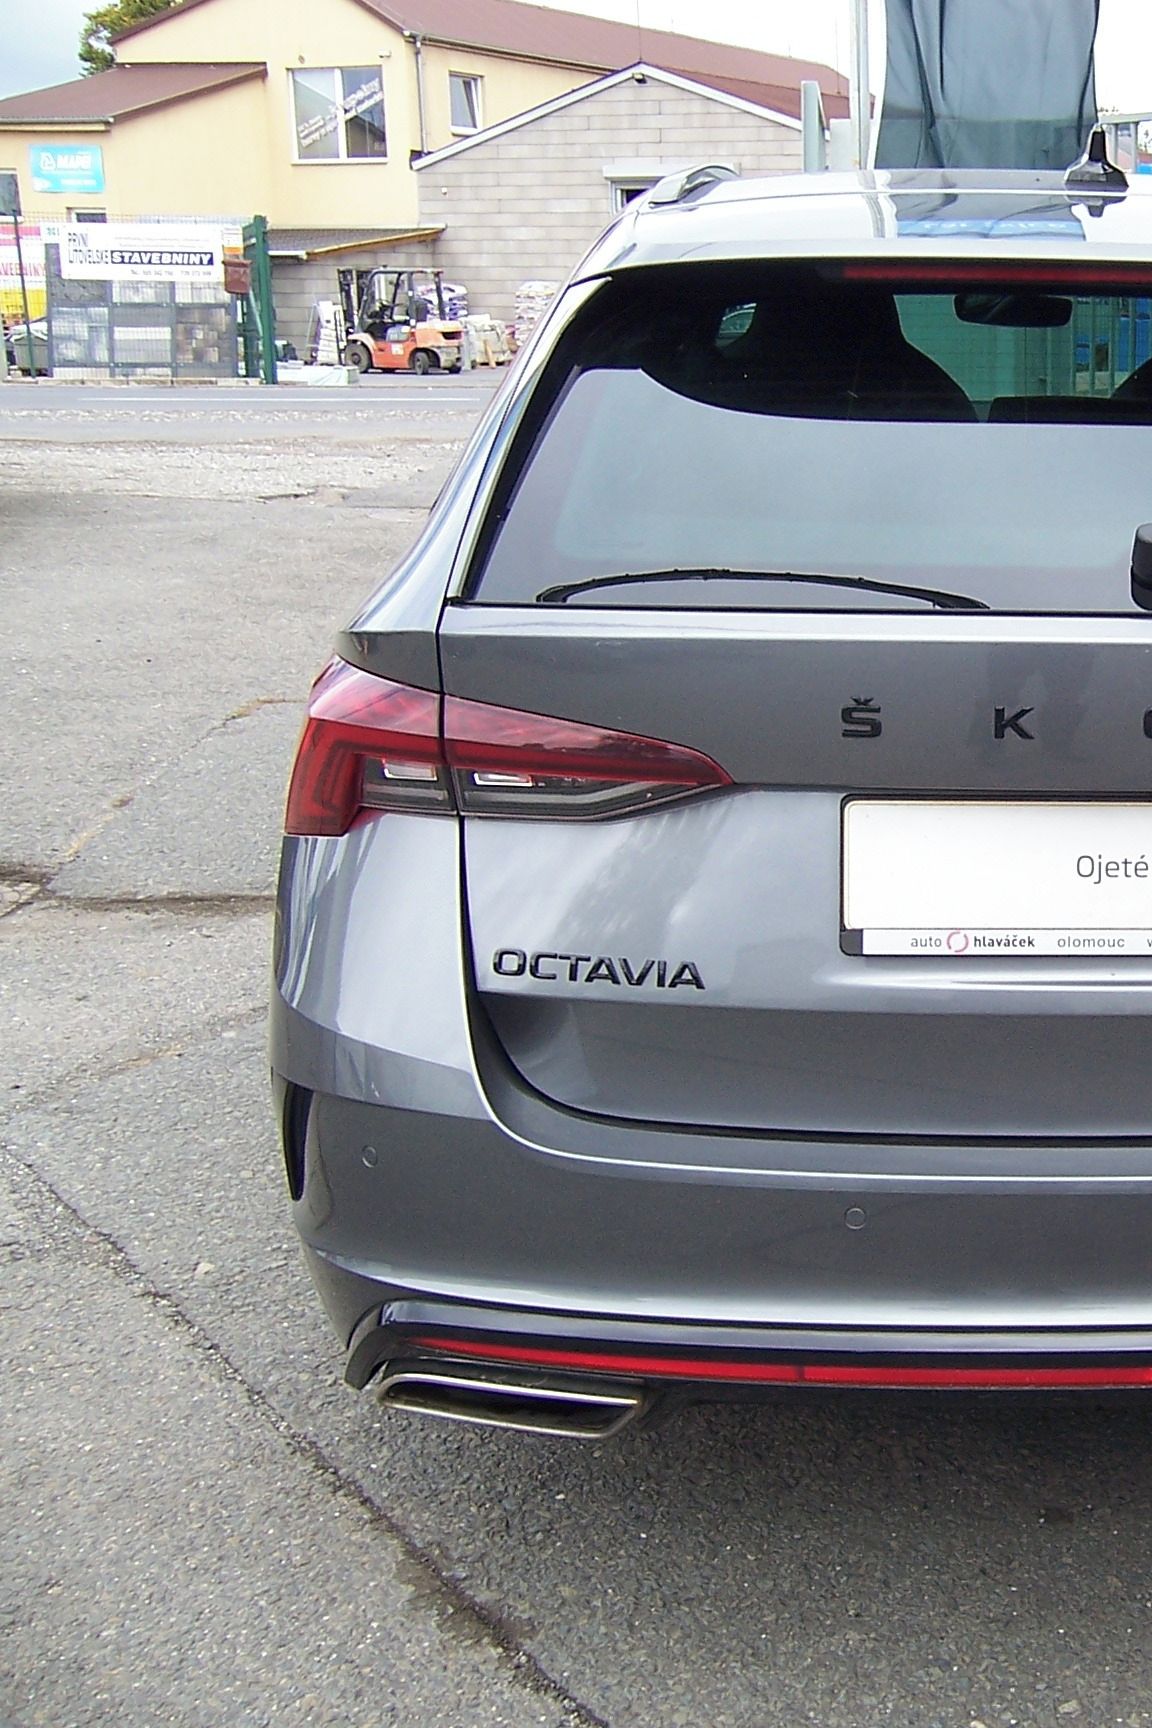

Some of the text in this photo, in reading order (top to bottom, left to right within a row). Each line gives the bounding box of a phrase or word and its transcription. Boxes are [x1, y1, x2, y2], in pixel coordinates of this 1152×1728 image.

[112, 251, 211, 264] STAVEBNINY
[1077, 855, 1148, 884] Ojeté
[911, 937, 941, 947] auto
[974, 935, 1034, 947] hlaváček
[1058, 937, 1124, 947] olomouc
[493, 949, 705, 990] OCTAVIA
